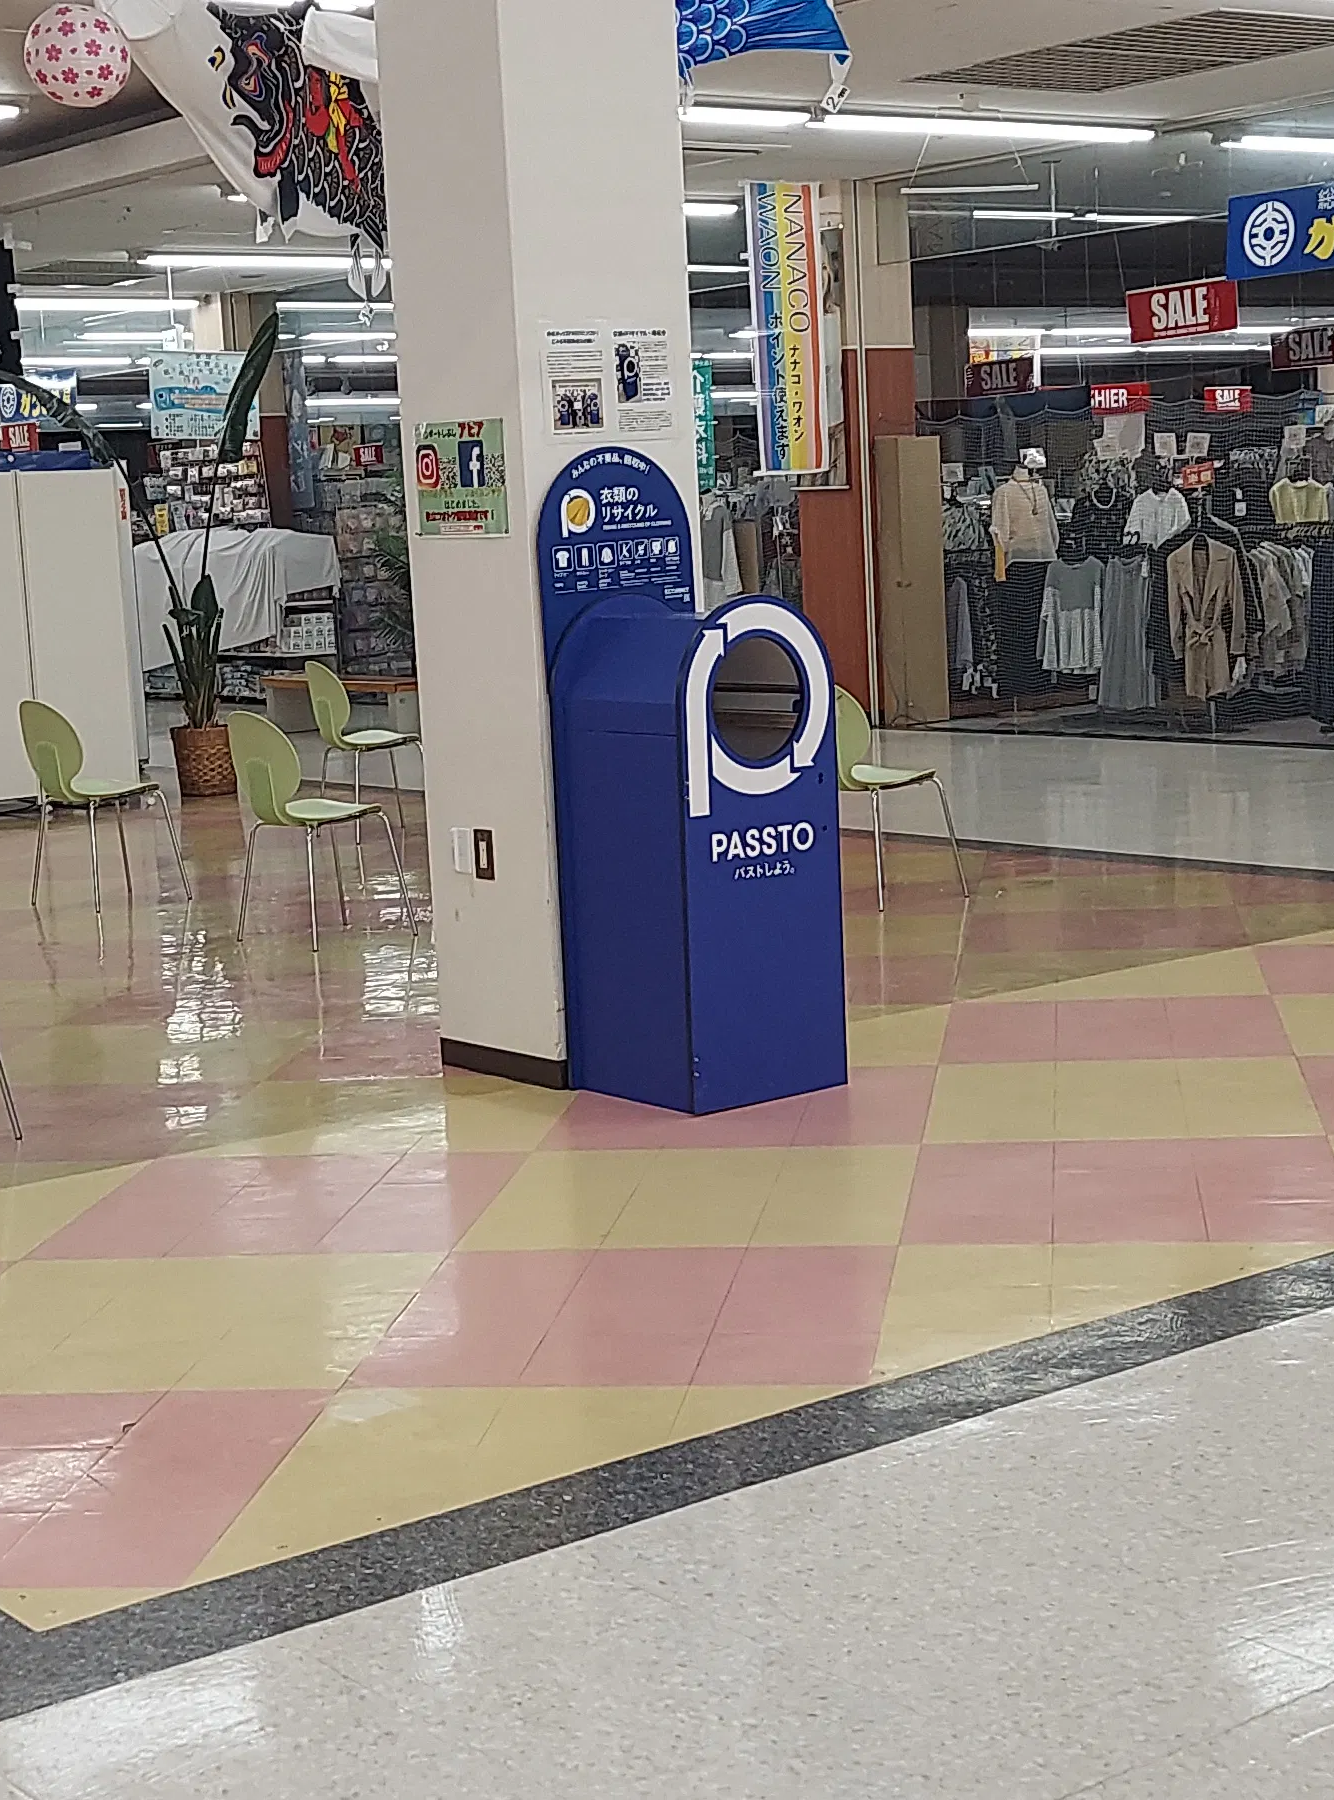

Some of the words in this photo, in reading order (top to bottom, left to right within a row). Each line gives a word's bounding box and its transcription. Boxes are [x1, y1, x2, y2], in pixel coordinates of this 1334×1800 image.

[758, 192, 782, 291] WAON
[782, 193, 811, 333] NANACO
[1151, 287, 1209, 330] SALE
[1289, 328, 1334, 361] SALE
[768, 312, 788, 460] ポイント使えます
[980, 364, 1018, 391] SALE
[789, 344, 804, 442] ナナコ・ワオン
[1215, 389, 1240, 405] SALE
[9, 425, 30, 447] SALE
[359, 446, 377, 462] SALE
[599, 486, 639, 504] 衣類の
[601, 504, 658, 522] リサイクル
[712, 821, 814, 862] PASSTO
[733, 860, 796, 880] パストしよう。
